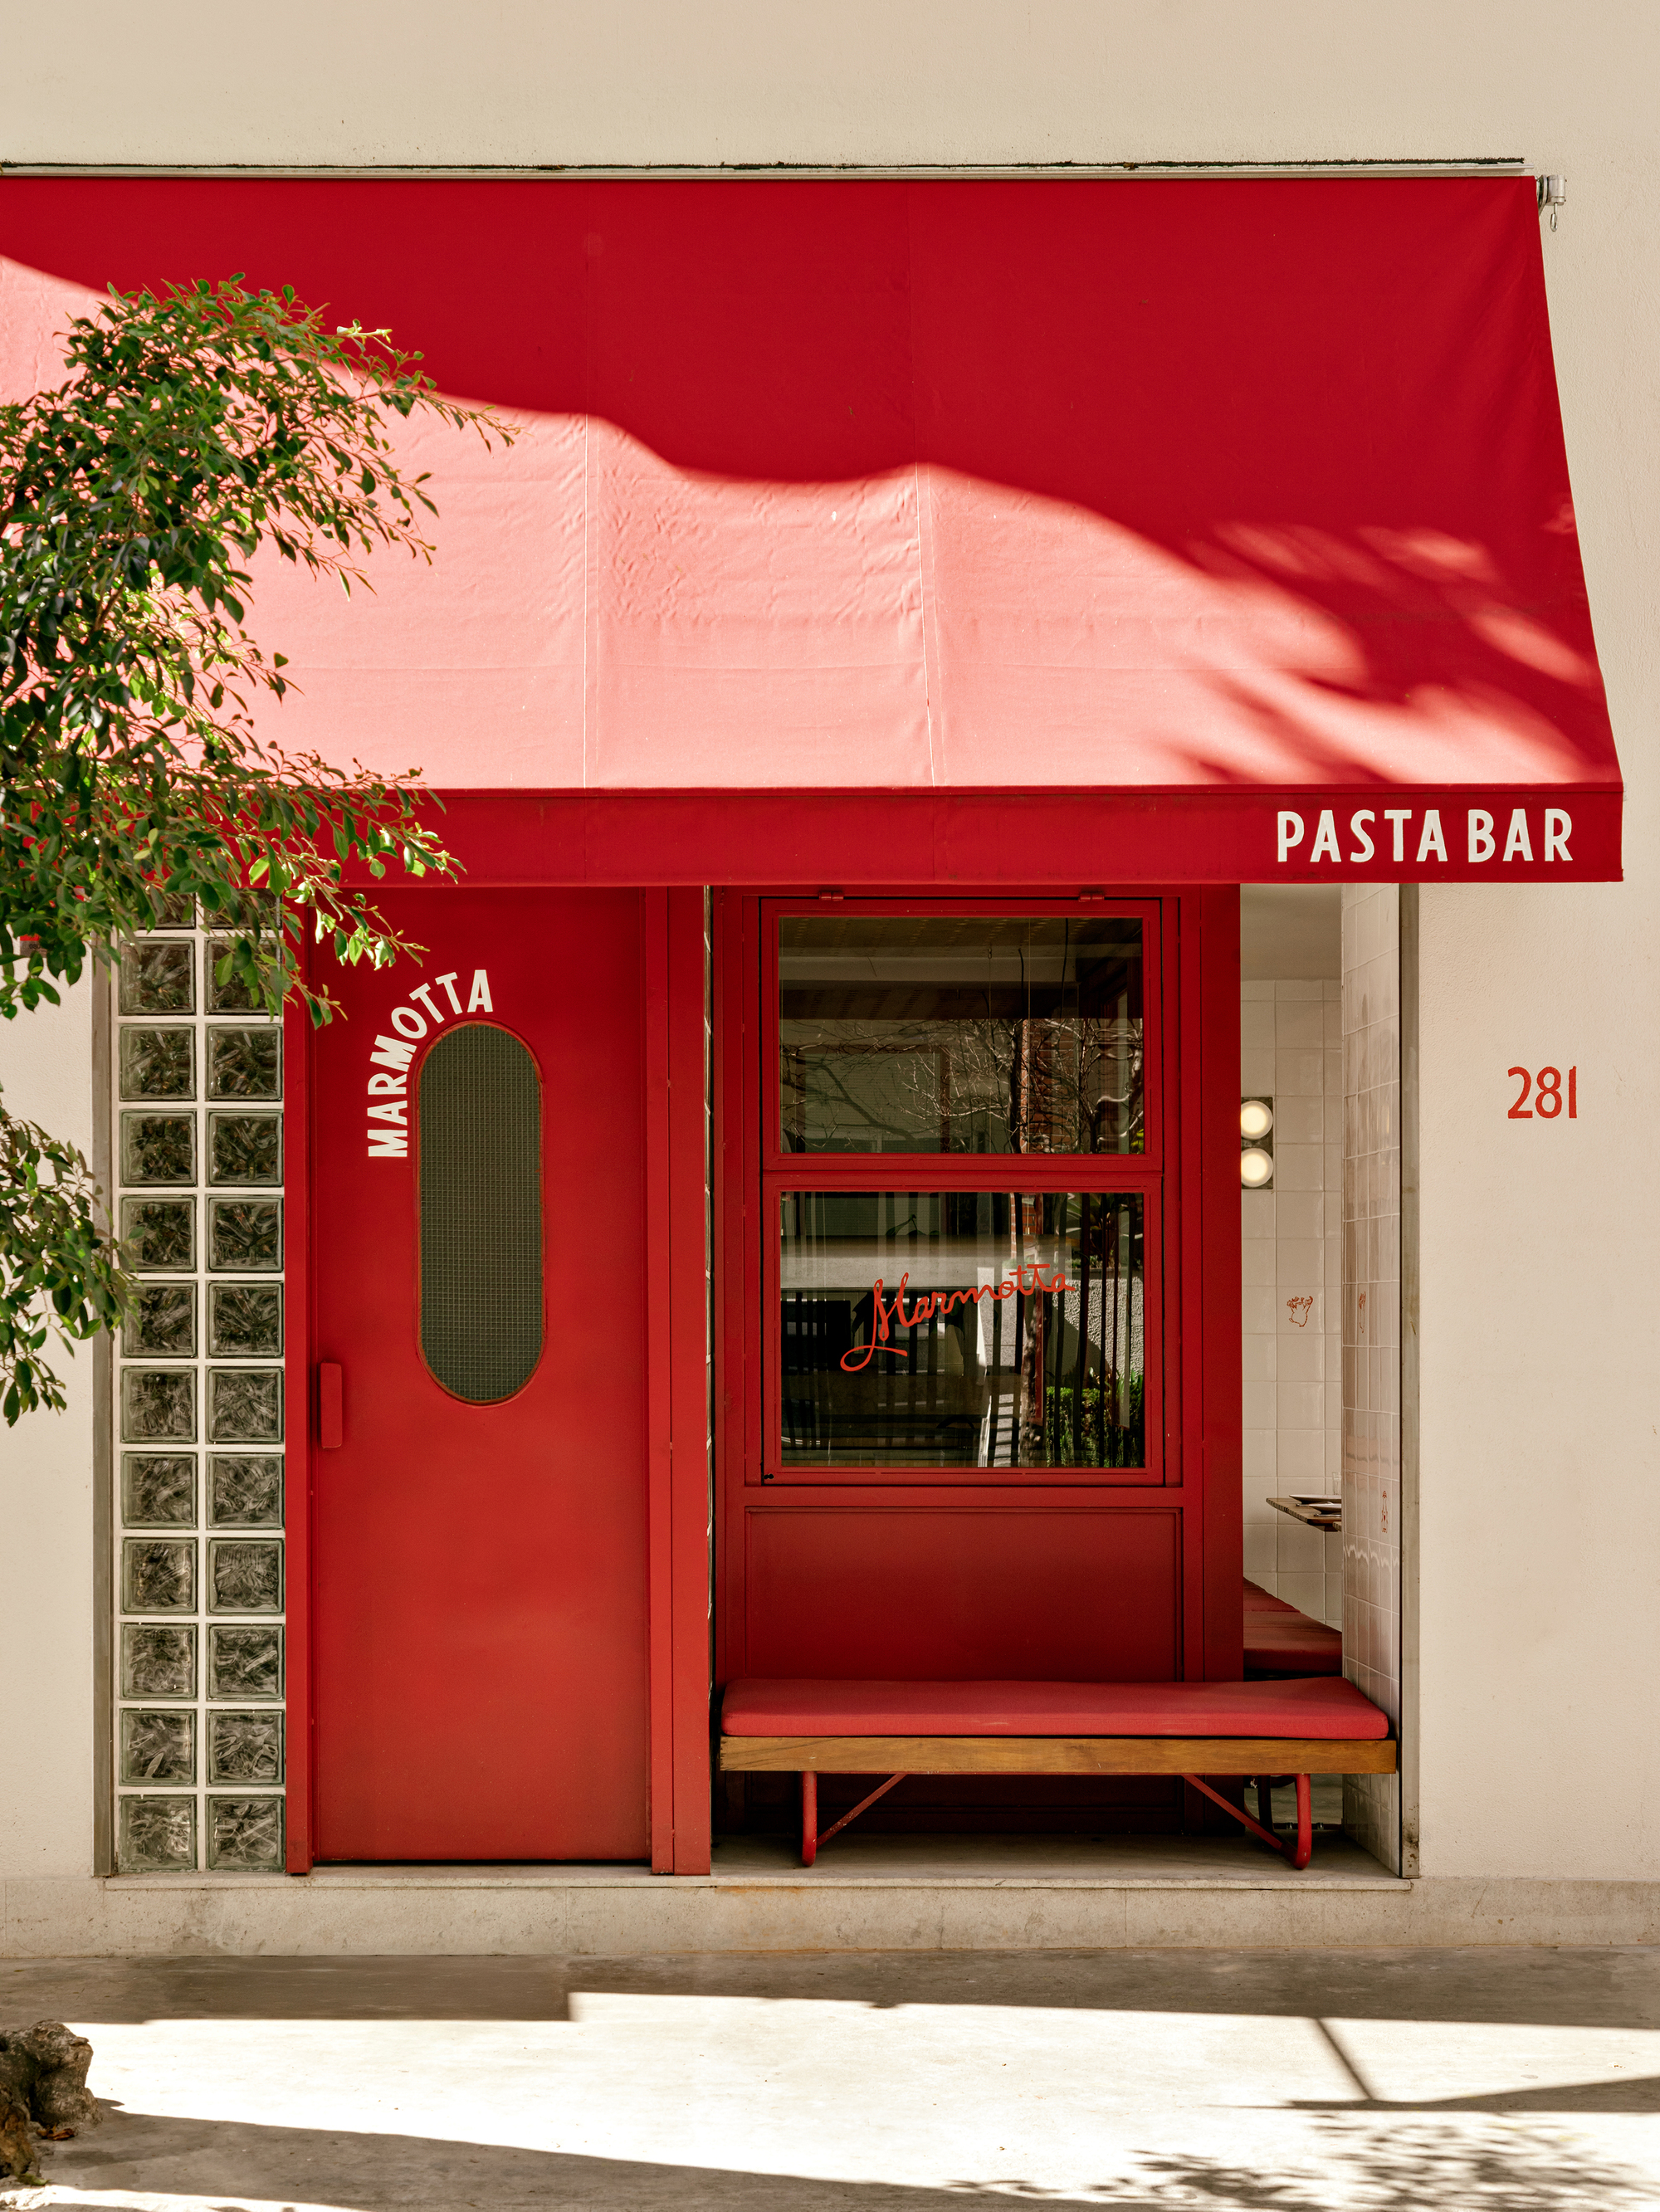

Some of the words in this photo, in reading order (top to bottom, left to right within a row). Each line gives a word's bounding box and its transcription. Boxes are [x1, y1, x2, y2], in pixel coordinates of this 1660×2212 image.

[1277, 809, 1448, 863] PASTA
[1467, 808, 1575, 863] BAR
[367, 969, 494, 1158] MARMOTTA
[1507, 1065, 1578, 1120] 281
[840, 1263, 1077, 1372] Marmotta
